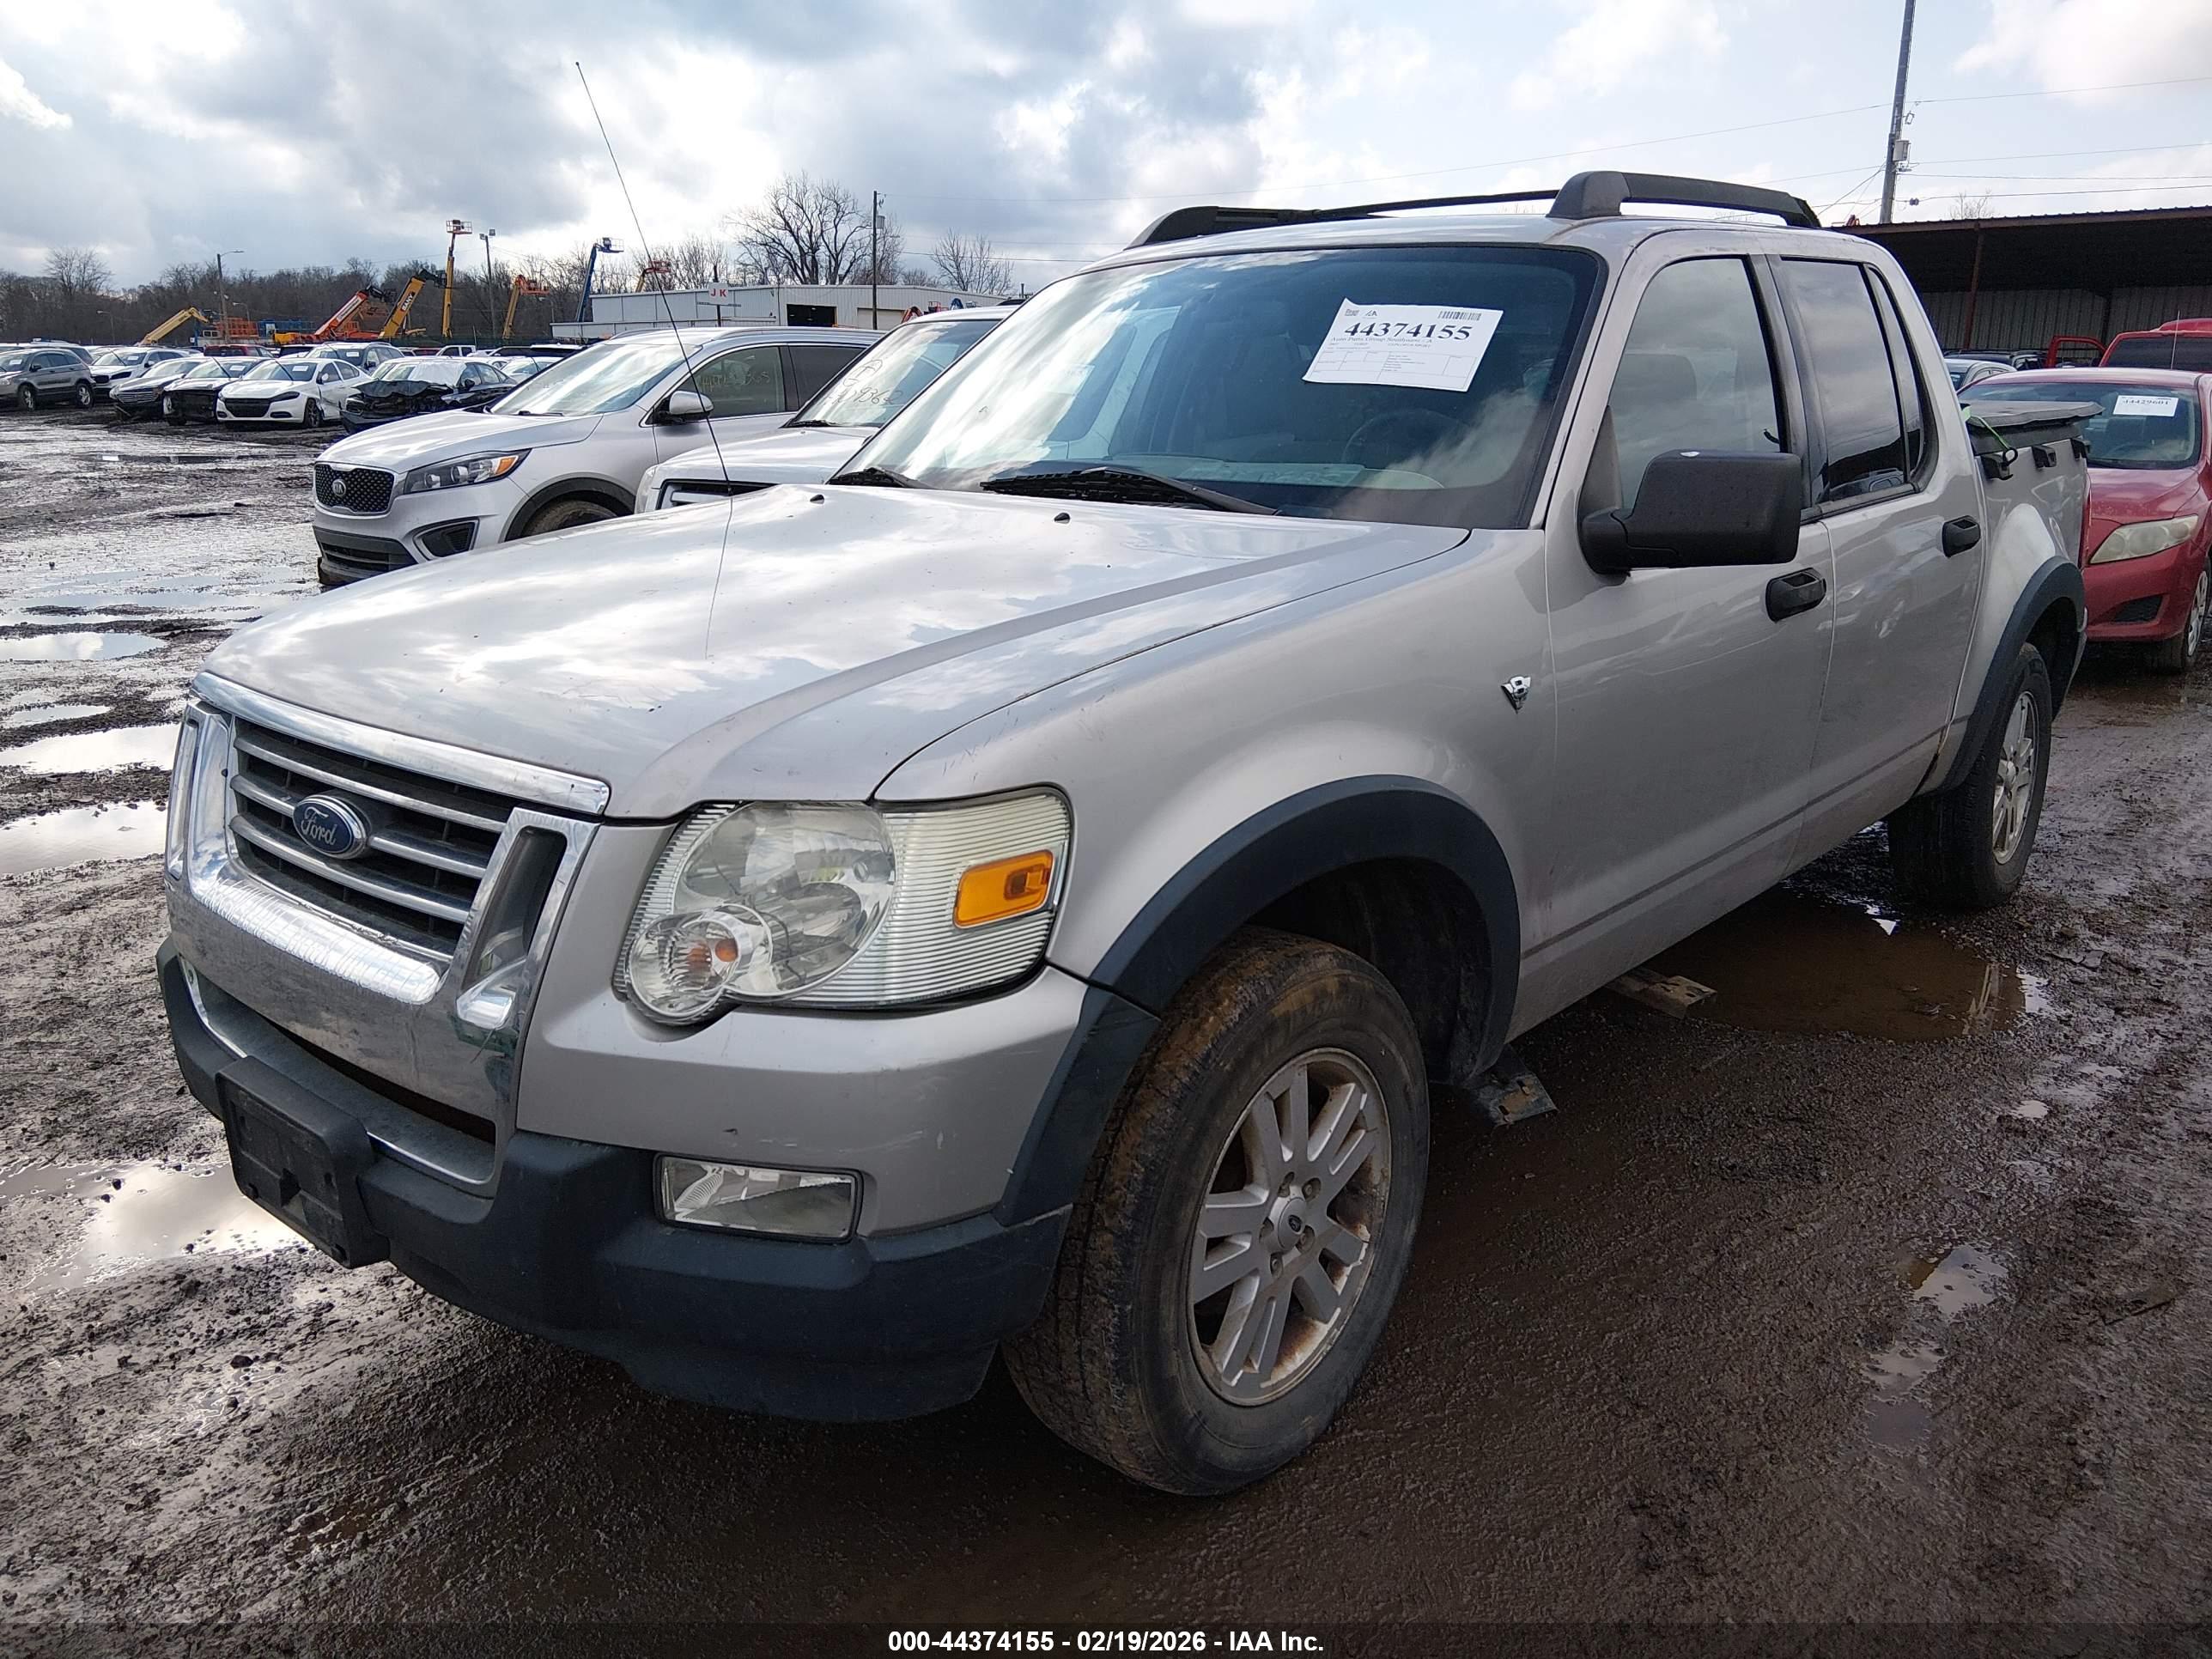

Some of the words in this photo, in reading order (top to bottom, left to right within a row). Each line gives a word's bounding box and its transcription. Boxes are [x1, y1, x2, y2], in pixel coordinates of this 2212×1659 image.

[711, 288, 716, 296] J
[720, 289, 727, 297] K
[1345, 322, 1474, 341] 44374155
[301, 806, 337, 846] Ford
